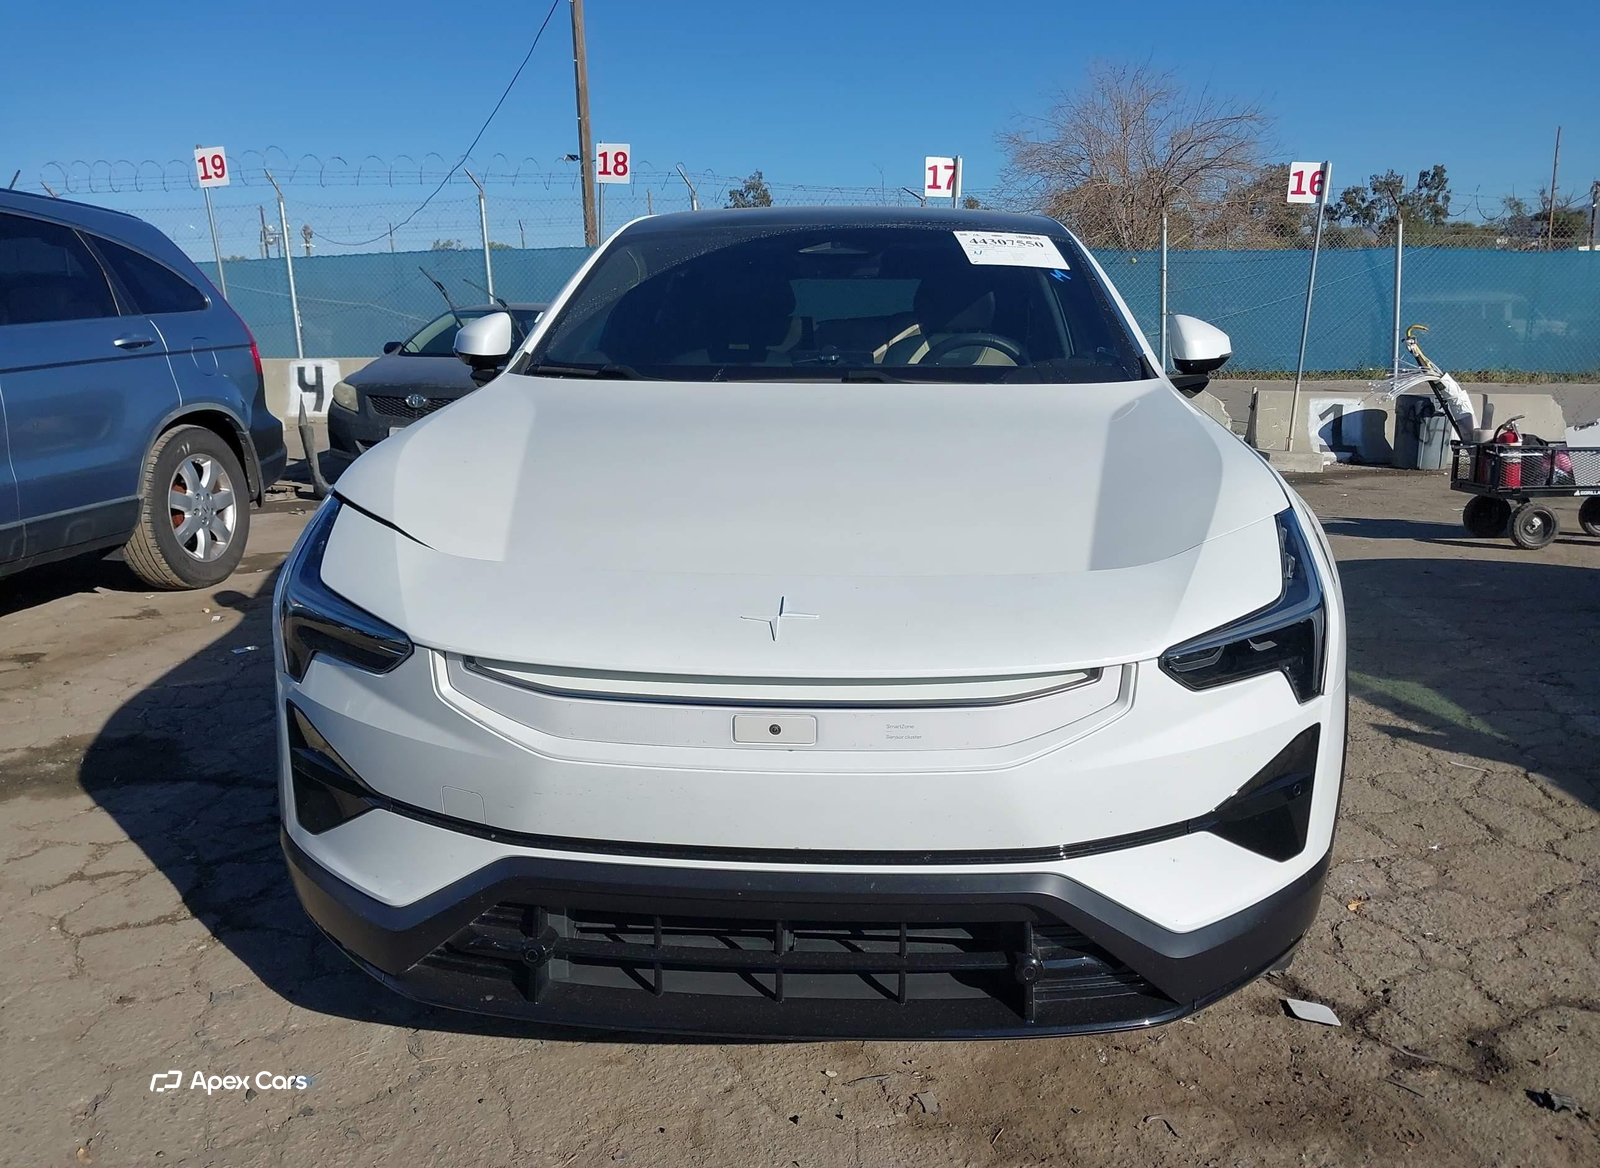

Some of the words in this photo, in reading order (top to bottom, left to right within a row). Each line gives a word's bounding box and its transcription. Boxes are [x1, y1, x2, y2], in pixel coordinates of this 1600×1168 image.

[198, 154, 226, 180] 19
[598, 151, 628, 177] 18
[927, 165, 956, 190] 17
[1290, 170, 1325, 196] 16
[969, 238, 1045, 248] 44307550
[297, 366, 325, 413] 4
[1318, 403, 1360, 454] 1
